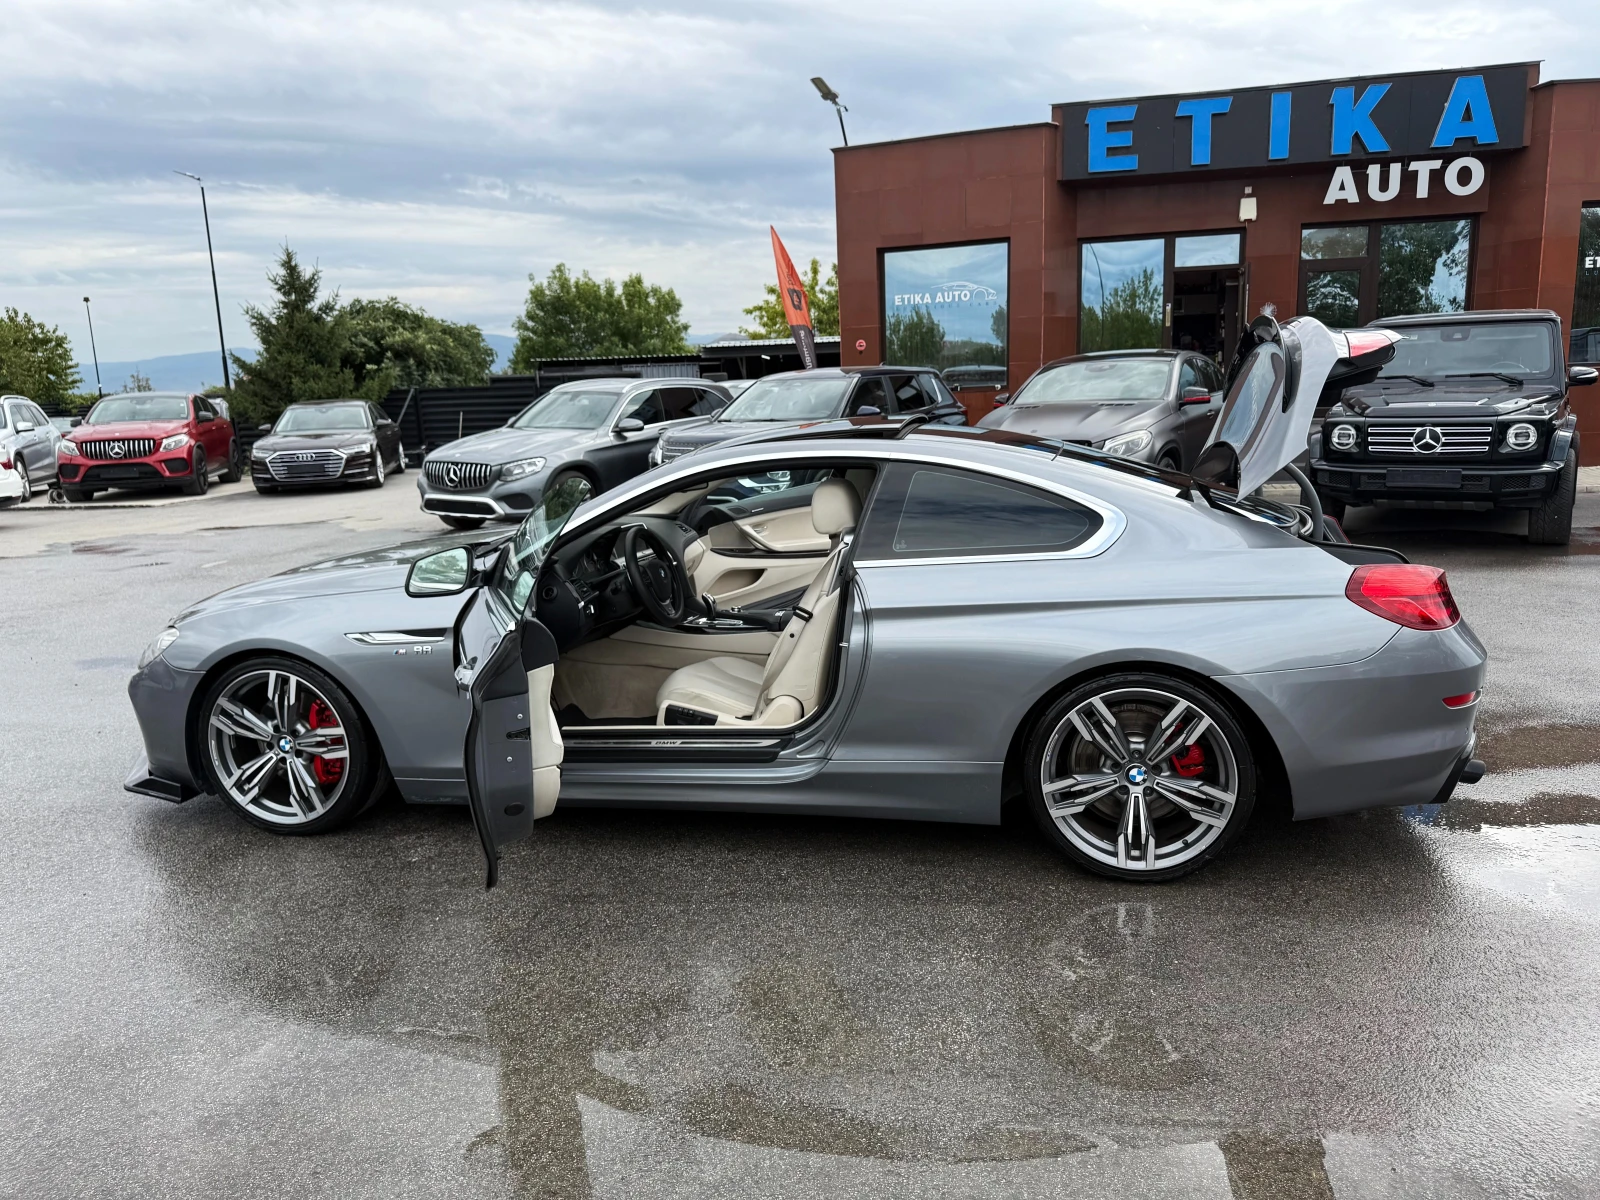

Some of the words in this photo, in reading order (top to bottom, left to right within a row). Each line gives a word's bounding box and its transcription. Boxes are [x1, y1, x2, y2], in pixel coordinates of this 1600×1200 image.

[1085, 75, 1499, 173] ETIKA
[1323, 157, 1485, 204] AUTO
[894, 293, 931, 306] ETIKA
[935, 290, 970, 303] AUTO
